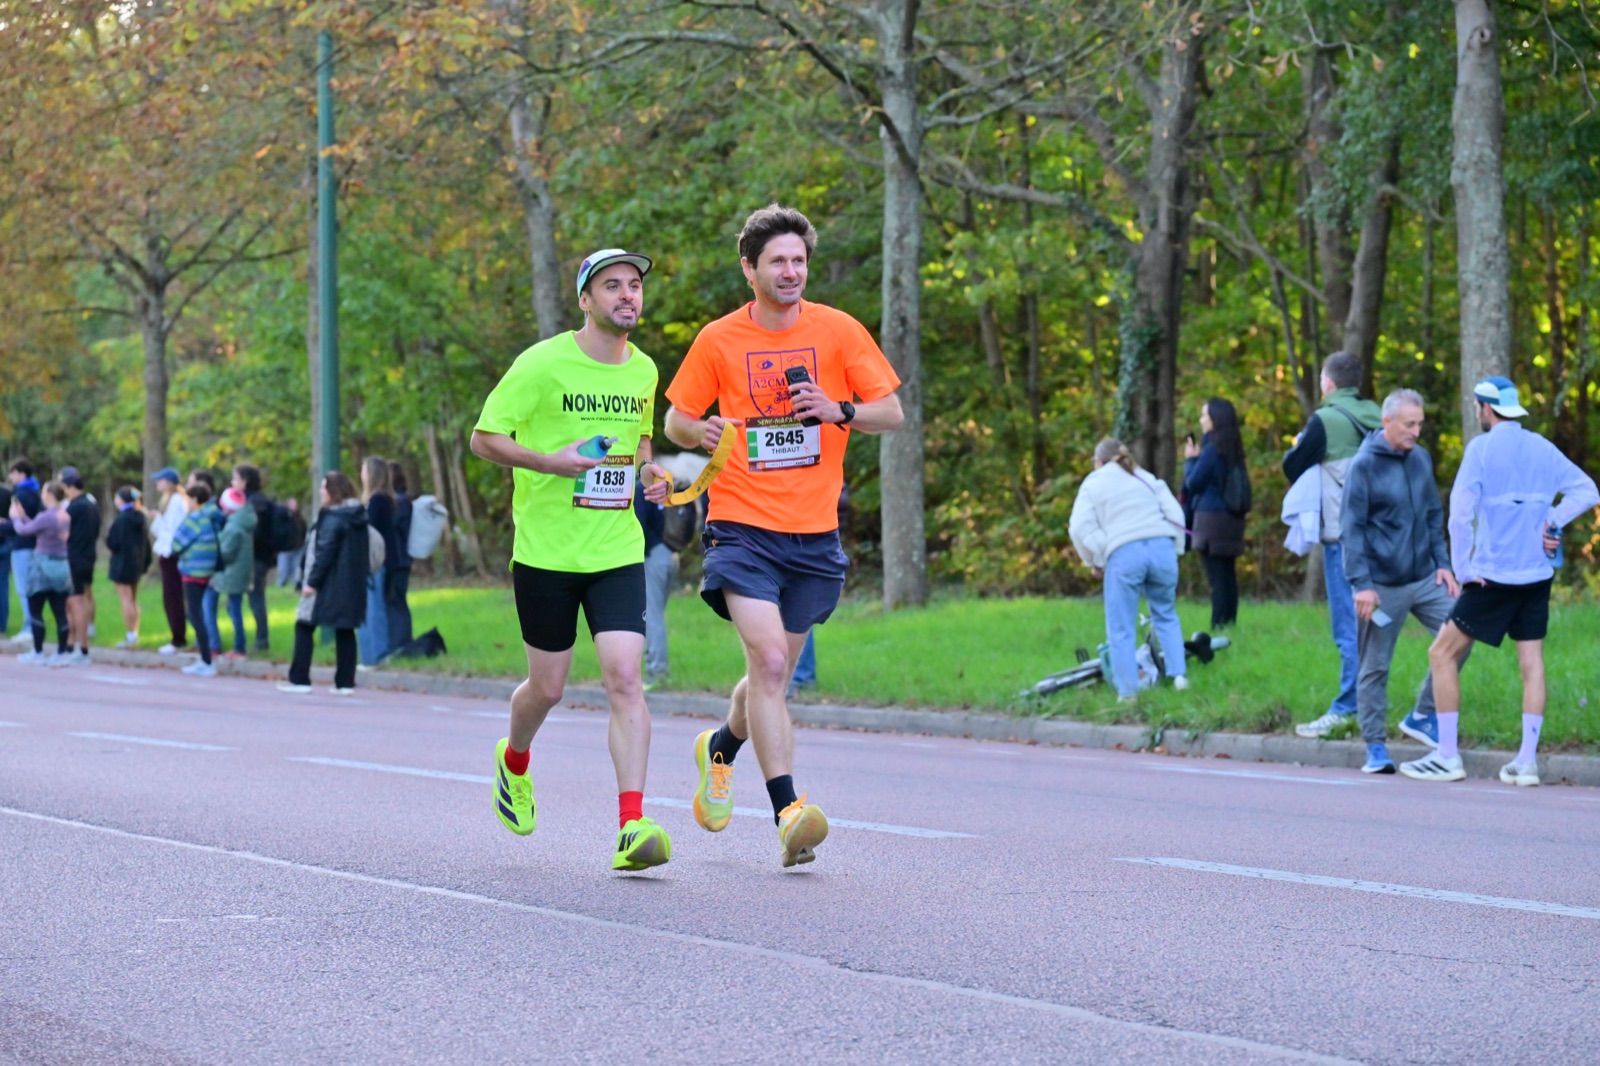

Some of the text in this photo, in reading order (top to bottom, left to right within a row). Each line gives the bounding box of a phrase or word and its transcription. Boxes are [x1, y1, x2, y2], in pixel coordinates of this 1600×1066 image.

[764, 429, 805, 447] 2645
[771, 446, 800, 454] THIBAUT
[594, 470, 626, 486] 1838
[591, 486, 624, 494] ALEXANDRE
